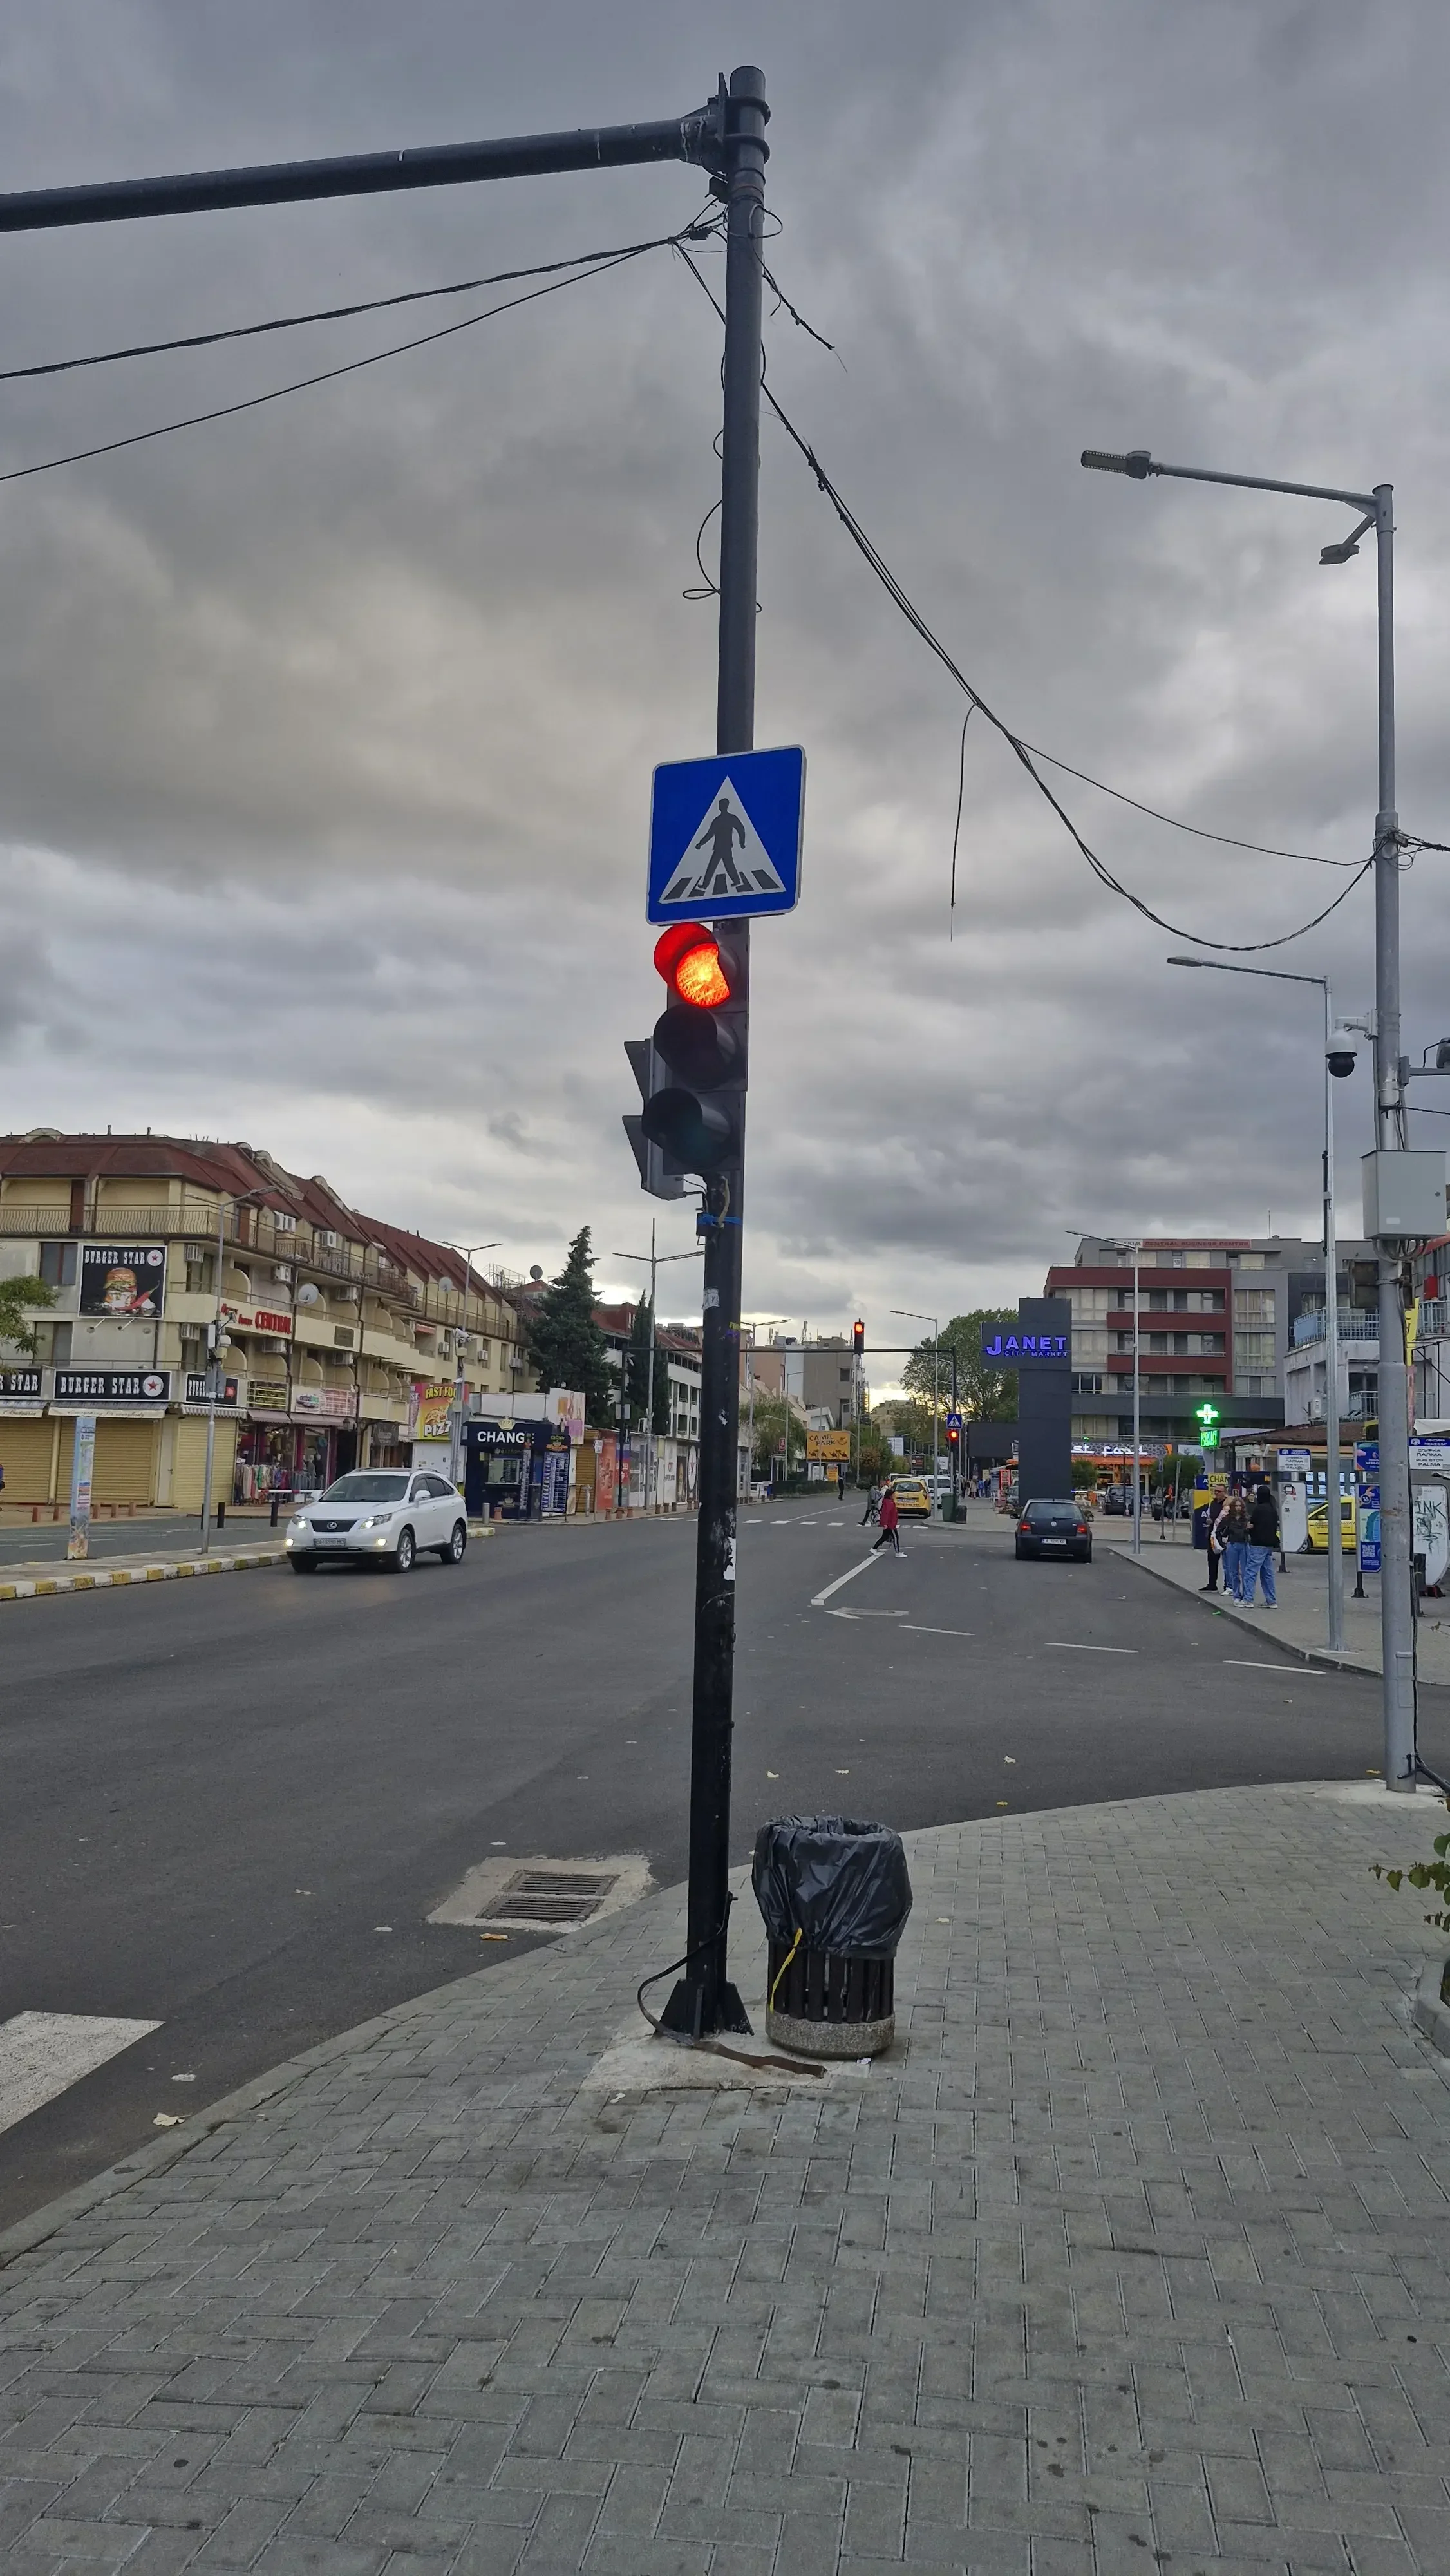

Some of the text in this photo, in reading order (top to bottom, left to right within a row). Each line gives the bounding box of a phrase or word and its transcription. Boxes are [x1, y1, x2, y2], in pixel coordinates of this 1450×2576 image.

[85, 1251, 146, 1265] BURGER STAR
[986, 1336, 1067, 1356] JANET
[10, 1374, 39, 1391] STAR
[61, 1376, 140, 1394] BURGER STAR
[426, 1386, 444, 1400] FAST
